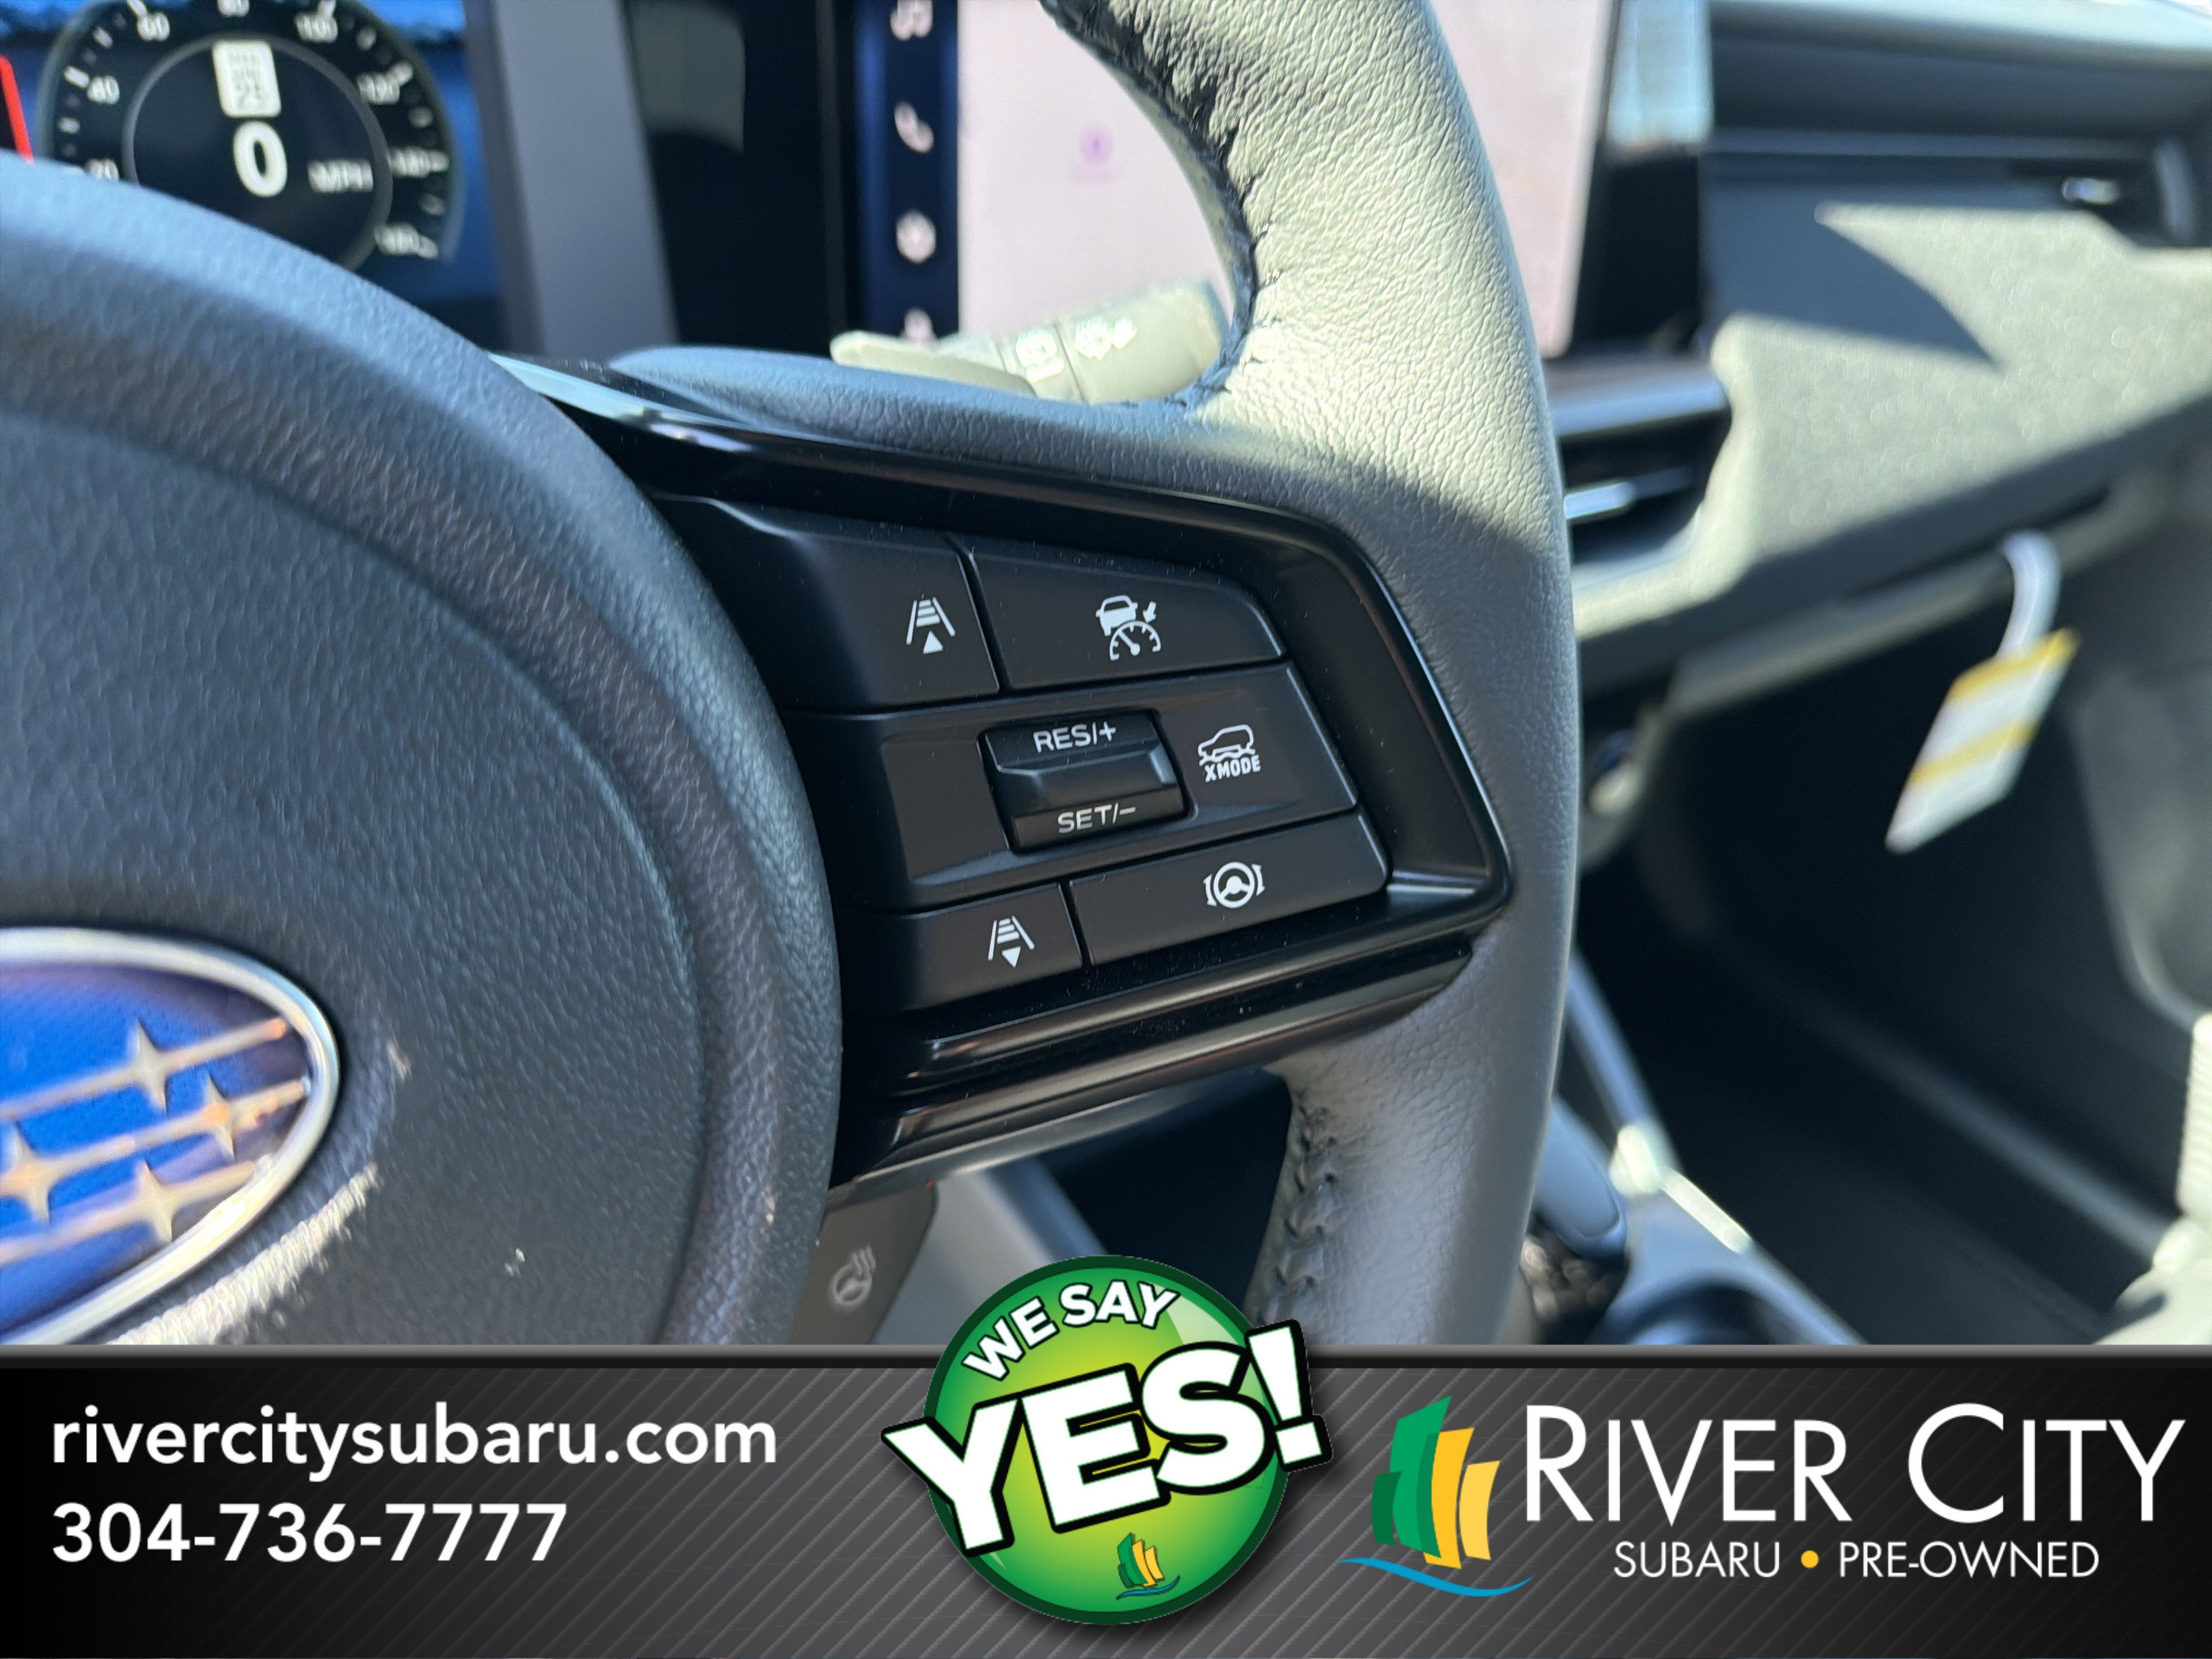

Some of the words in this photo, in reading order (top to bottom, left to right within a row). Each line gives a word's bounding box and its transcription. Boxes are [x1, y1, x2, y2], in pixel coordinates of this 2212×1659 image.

[87, 76, 120, 104] 40
[233, 120, 287, 198] 0
[1033, 721, 1117, 753] RES/+
[1204, 754, 1261, 782] XMODE
